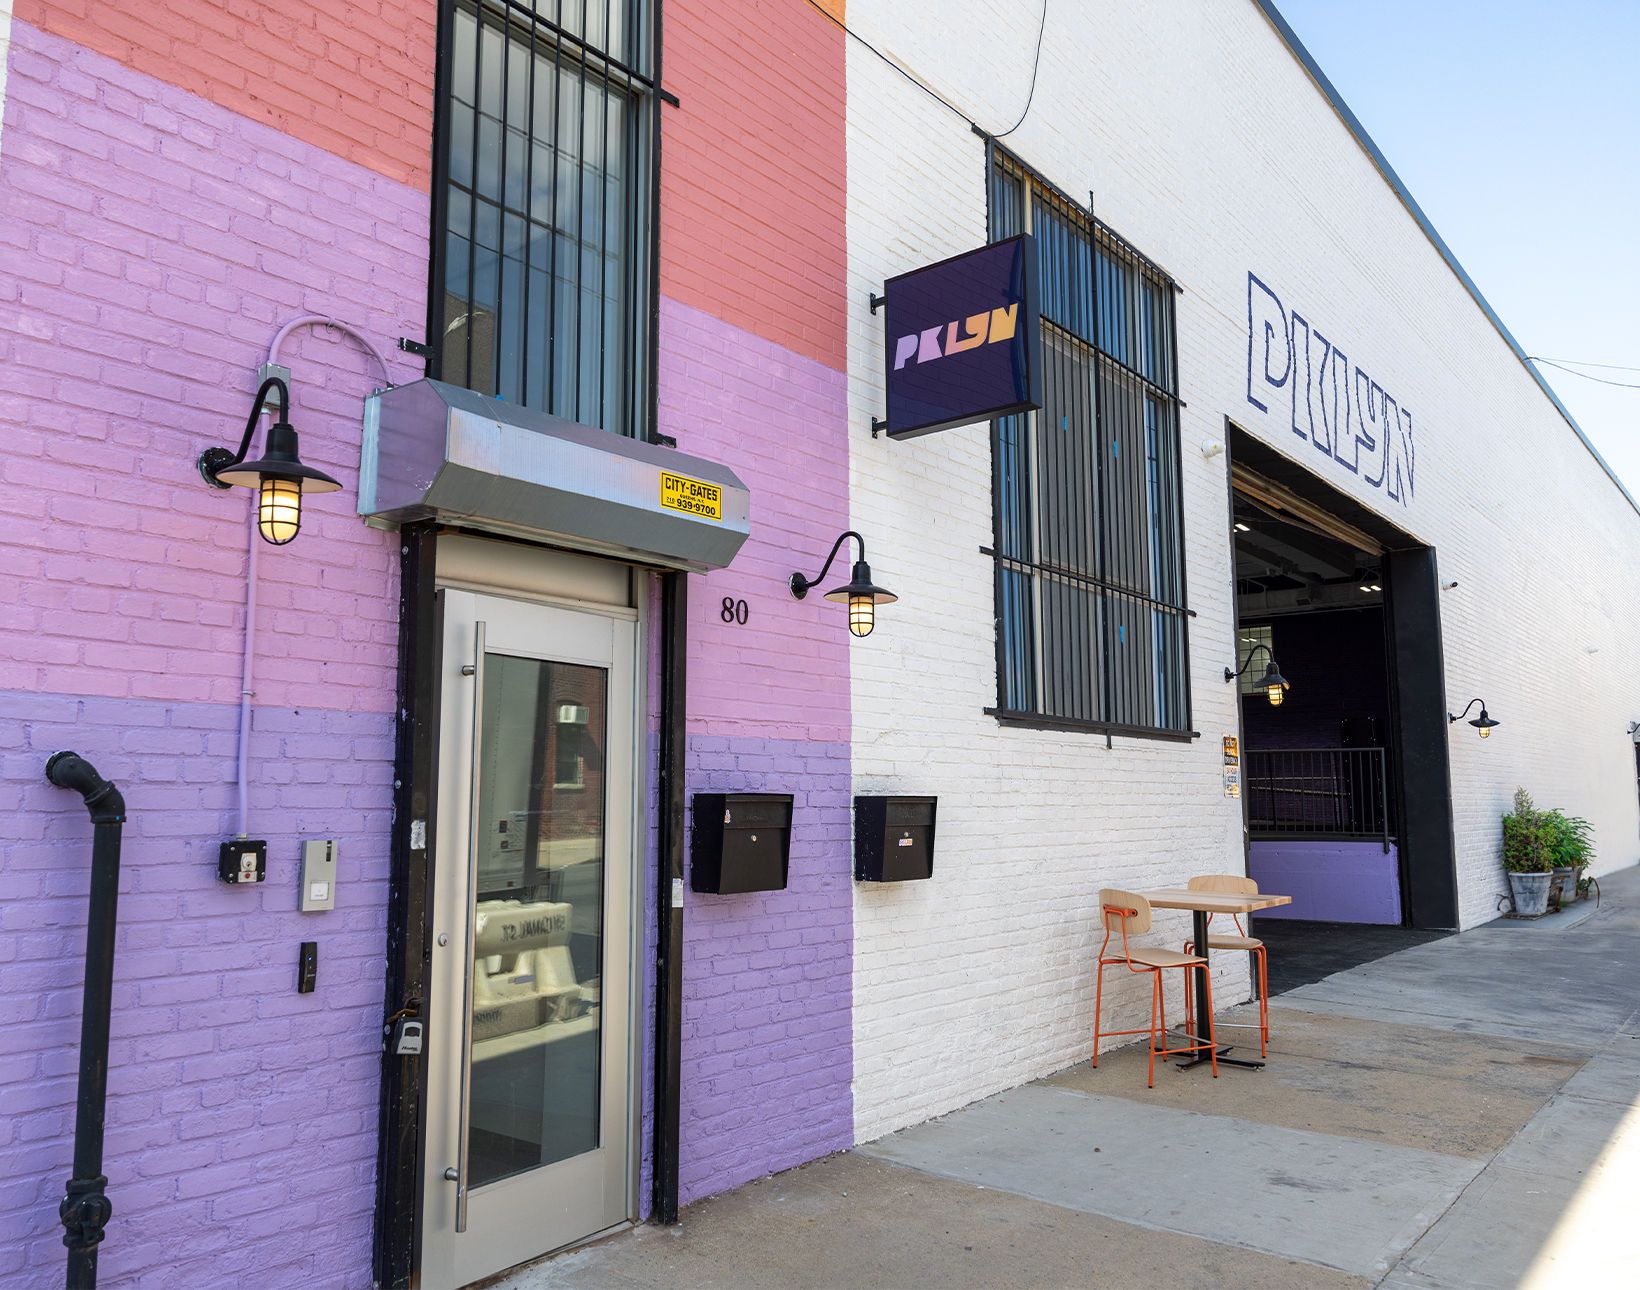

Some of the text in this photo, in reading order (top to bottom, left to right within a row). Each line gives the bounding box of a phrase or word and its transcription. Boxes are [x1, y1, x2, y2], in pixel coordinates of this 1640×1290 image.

[893, 302, 1019, 371] PKLYN
[665, 477, 718, 502] CITY-GATES
[721, 597, 749, 625] 80
